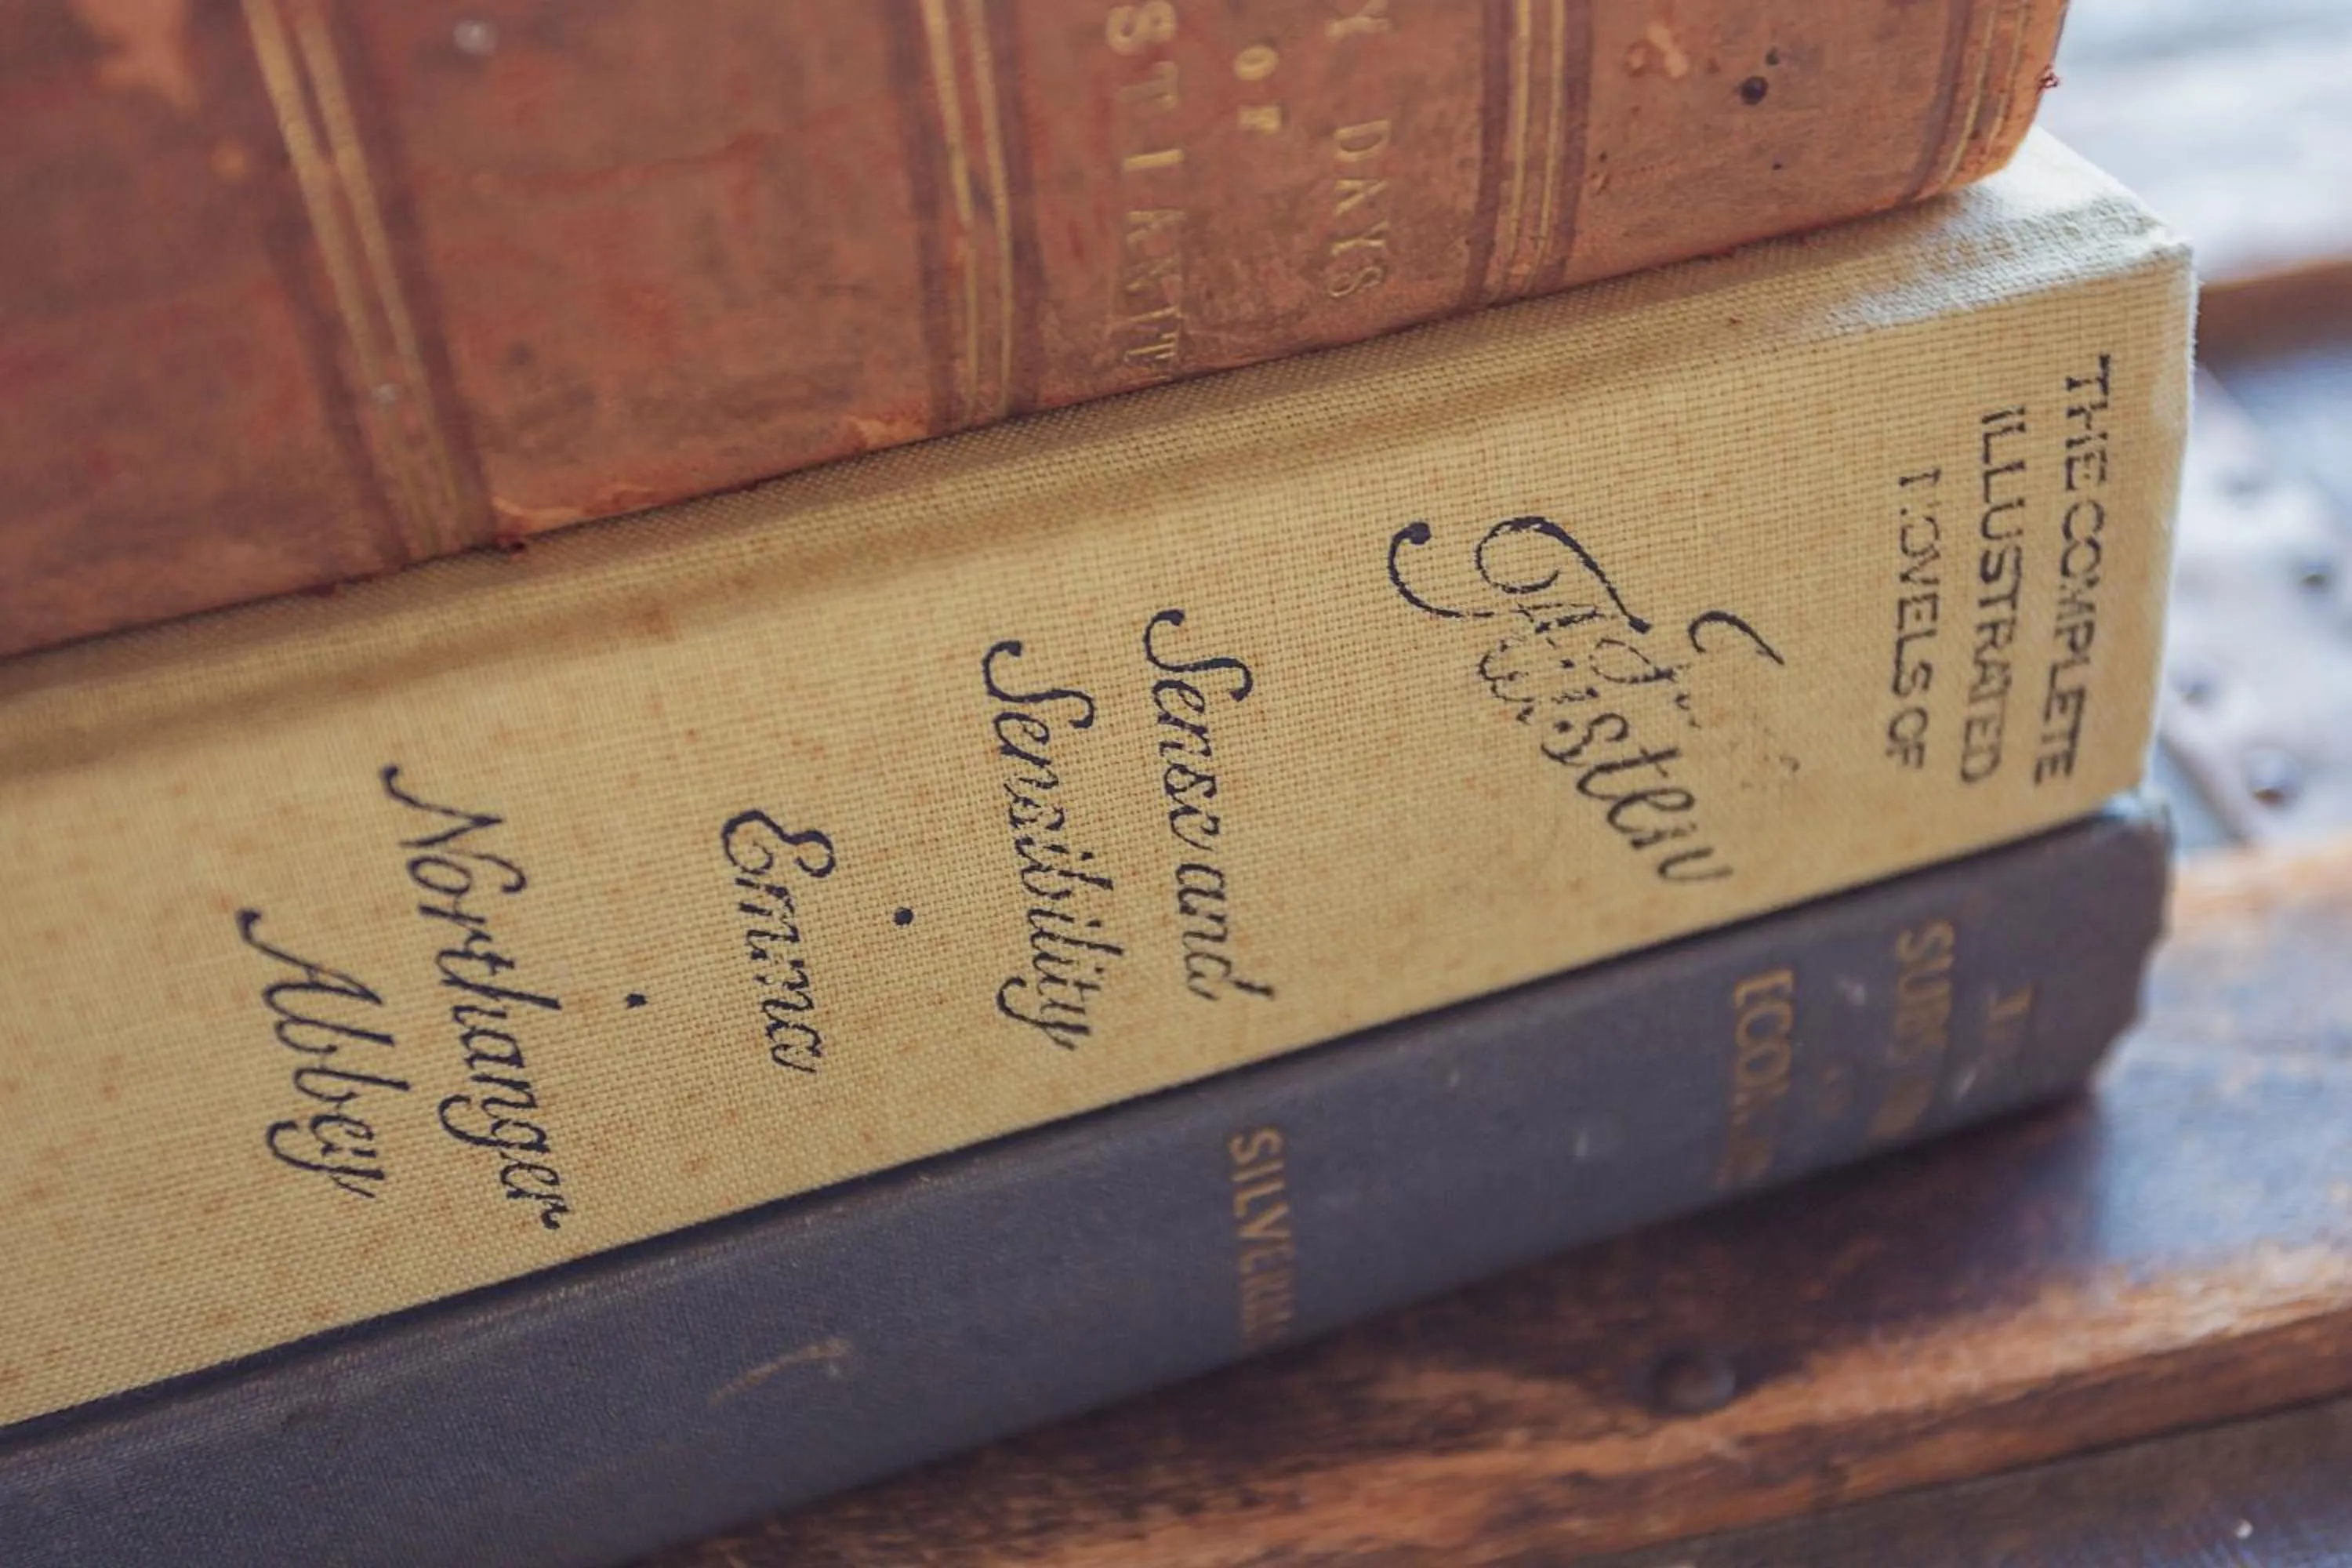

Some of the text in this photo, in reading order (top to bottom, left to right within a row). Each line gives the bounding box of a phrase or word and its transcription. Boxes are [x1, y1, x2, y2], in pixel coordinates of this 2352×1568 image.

[1327, 119, 1392, 299] DAYS
[1886, 706, 1929, 770] OF
[1961, 406, 2026, 784] ILLUSTRATED
[2035, 353, 2111, 786] THE COMPLETE
[720, 809, 837, 1074] Emma
[980, 639, 1127, 1051] Sensibility
[1142, 608, 1276, 1002] Sense and
[235, 908, 411, 1199] Abbey
[379, 764, 570, 1229] Northanger
